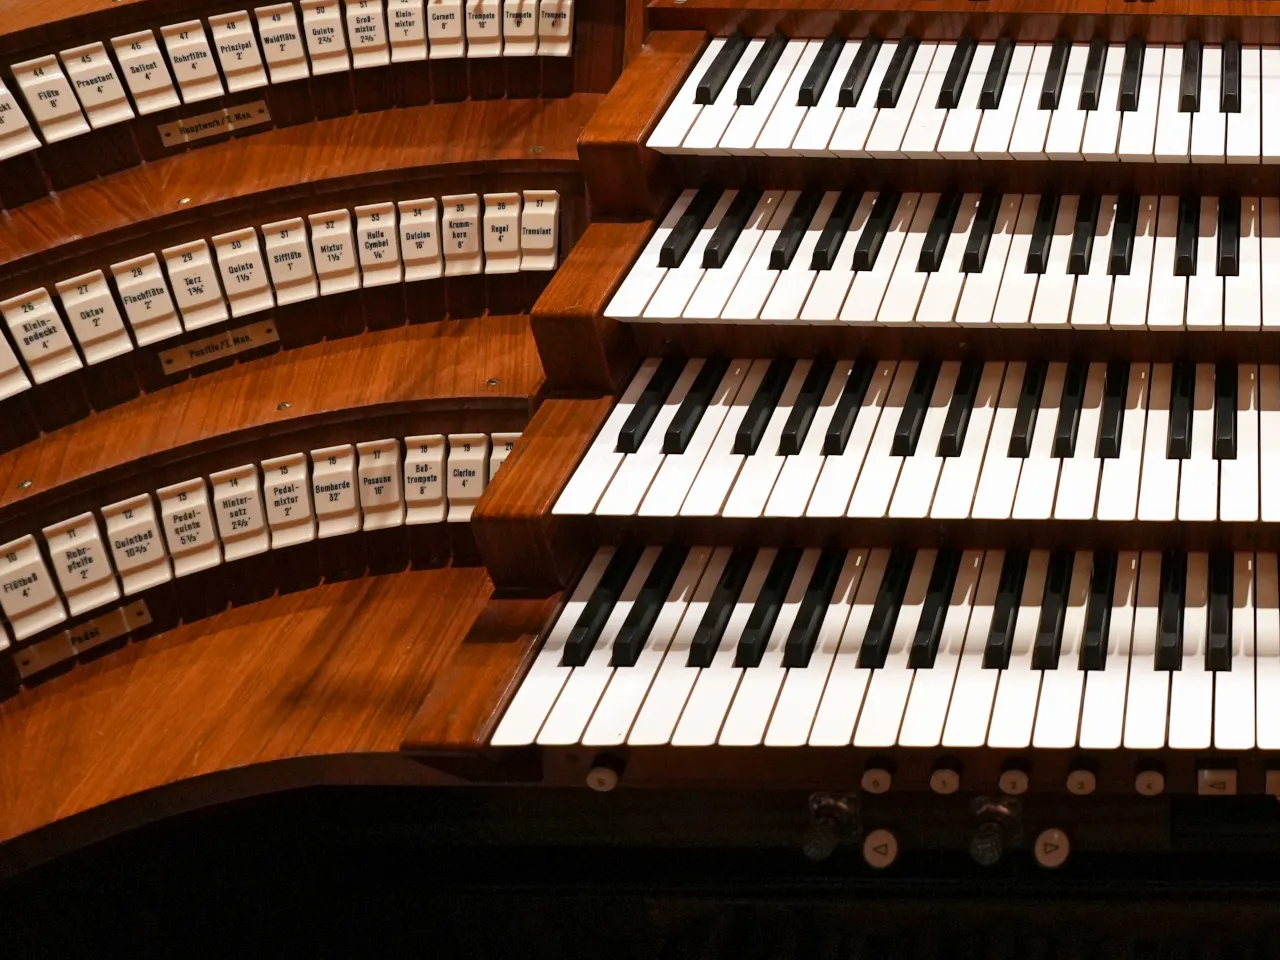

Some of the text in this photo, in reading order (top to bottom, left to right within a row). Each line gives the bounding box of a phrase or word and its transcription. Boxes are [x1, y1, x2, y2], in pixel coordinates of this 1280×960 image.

[226, 22, 236, 30] 48
[180, 31, 189, 40] 47
[131, 42, 142, 50] 46
[220, 41, 253, 54] Prinzipal
[81, 55, 91, 63] 45
[173, 50, 208, 64] Rohrflöte
[33, 68, 44, 77] 44
[76, 73, 114, 88] Praestant
[38, 90, 60, 100] Flöte
[371, 213, 379, 221] 33
[326, 221, 335, 229] 32
[492, 225, 509, 233] Regal
[367, 231, 384, 239] Helle
[406, 231, 430, 240] Dulcian
[523, 227, 551, 235] Tremulant
[232, 241, 241, 249] 30
[320, 244, 343, 253] Mixtur
[182, 254, 193, 262] 29
[132, 268, 143, 277] 28
[229, 263, 254, 273] Quinte
[184, 276, 202, 286] Terz
[78, 285, 89, 294] 27
[124, 287, 165, 305] Flachflöte
[22, 302, 34, 313] 26
[80, 307, 104, 319] Oktav
[23, 319, 51, 332] Klein-
[23, 325, 57, 345] gedeckt
[420, 445, 427, 453] 18
[374, 451, 381, 459] 17
[364, 476, 391, 485] Posaune
[407, 475, 437, 483] trompete
[274, 485, 299, 495] Pedal-
[315, 481, 350, 493] Bombarde
[223, 497, 252, 508] Hinter-
[274, 496, 298, 507] mixtur
[123, 510, 134, 519] 12
[173, 511, 201, 523] Pedal-
[230, 508, 247, 518] satz
[175, 521, 200, 534] quinte
[67, 530, 76, 538] 11
[67, 546, 91, 559] Rohr-
[6, 553, 17, 562] 10
